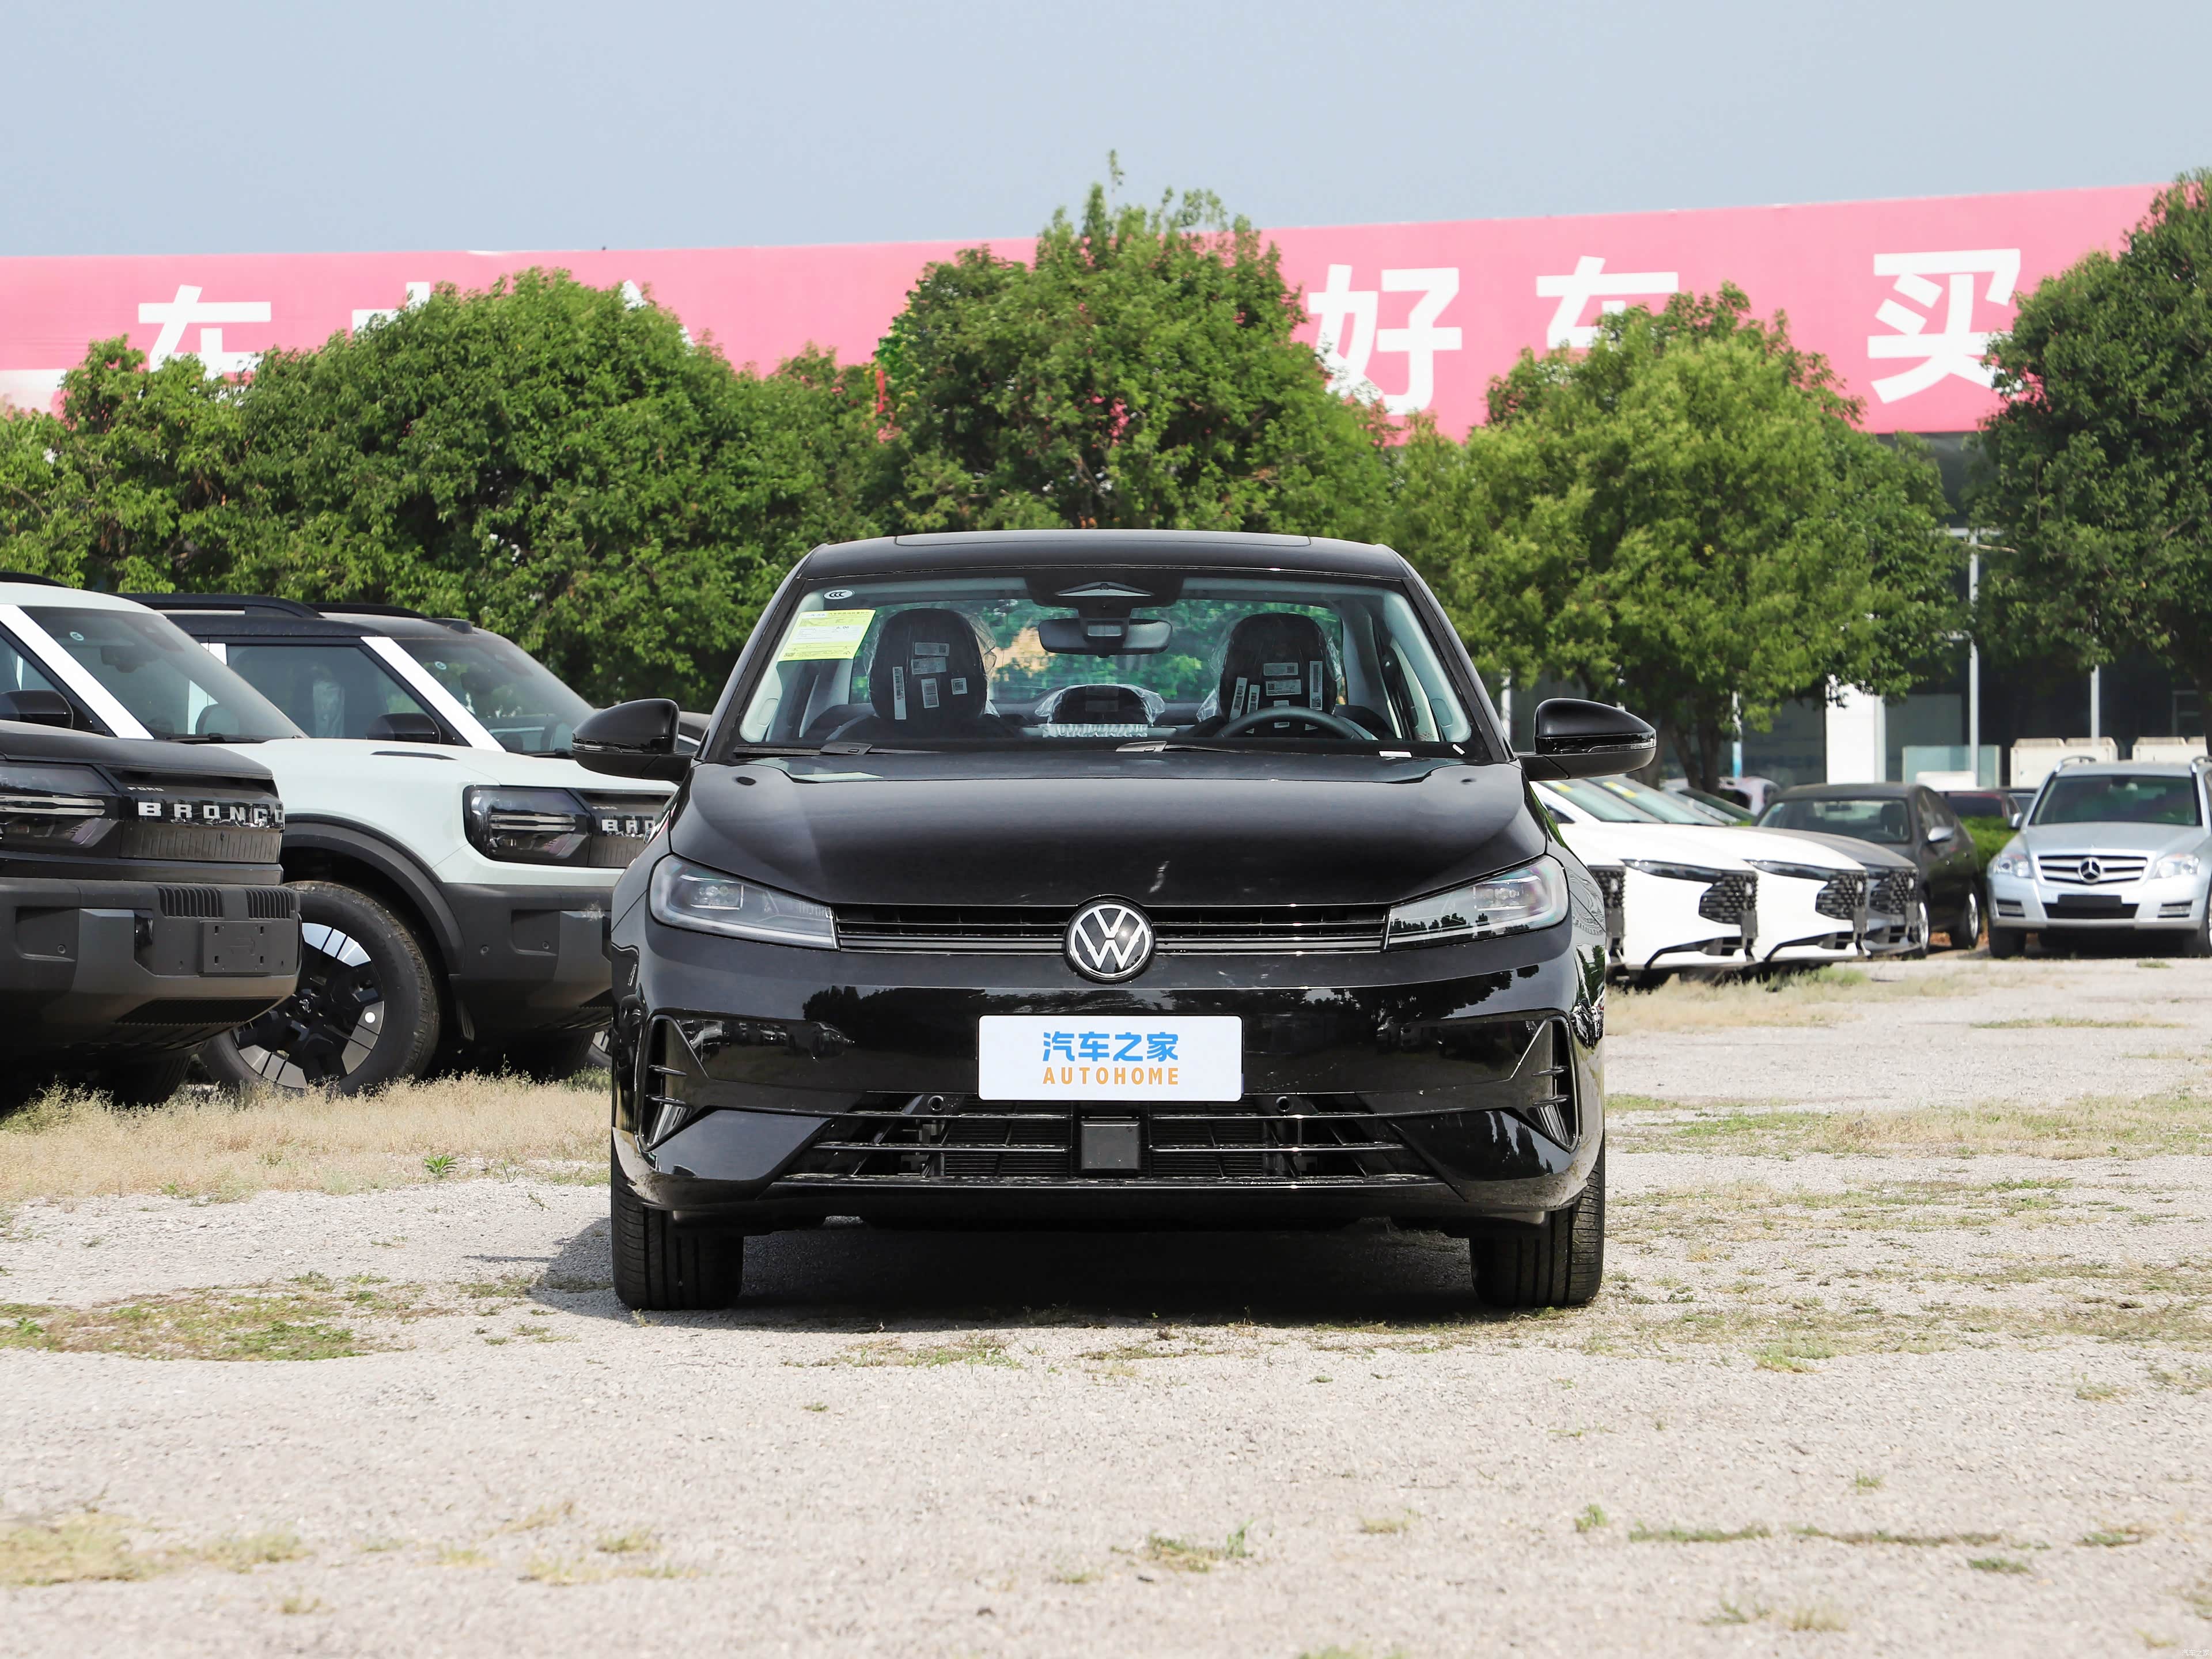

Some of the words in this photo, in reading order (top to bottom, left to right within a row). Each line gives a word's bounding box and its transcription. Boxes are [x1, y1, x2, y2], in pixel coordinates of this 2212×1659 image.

[138, 801, 283, 825] BRONCO
[1043, 1031, 1179, 1062] 汽车之家
[1043, 1067, 1179, 1085] AUTOHOME
